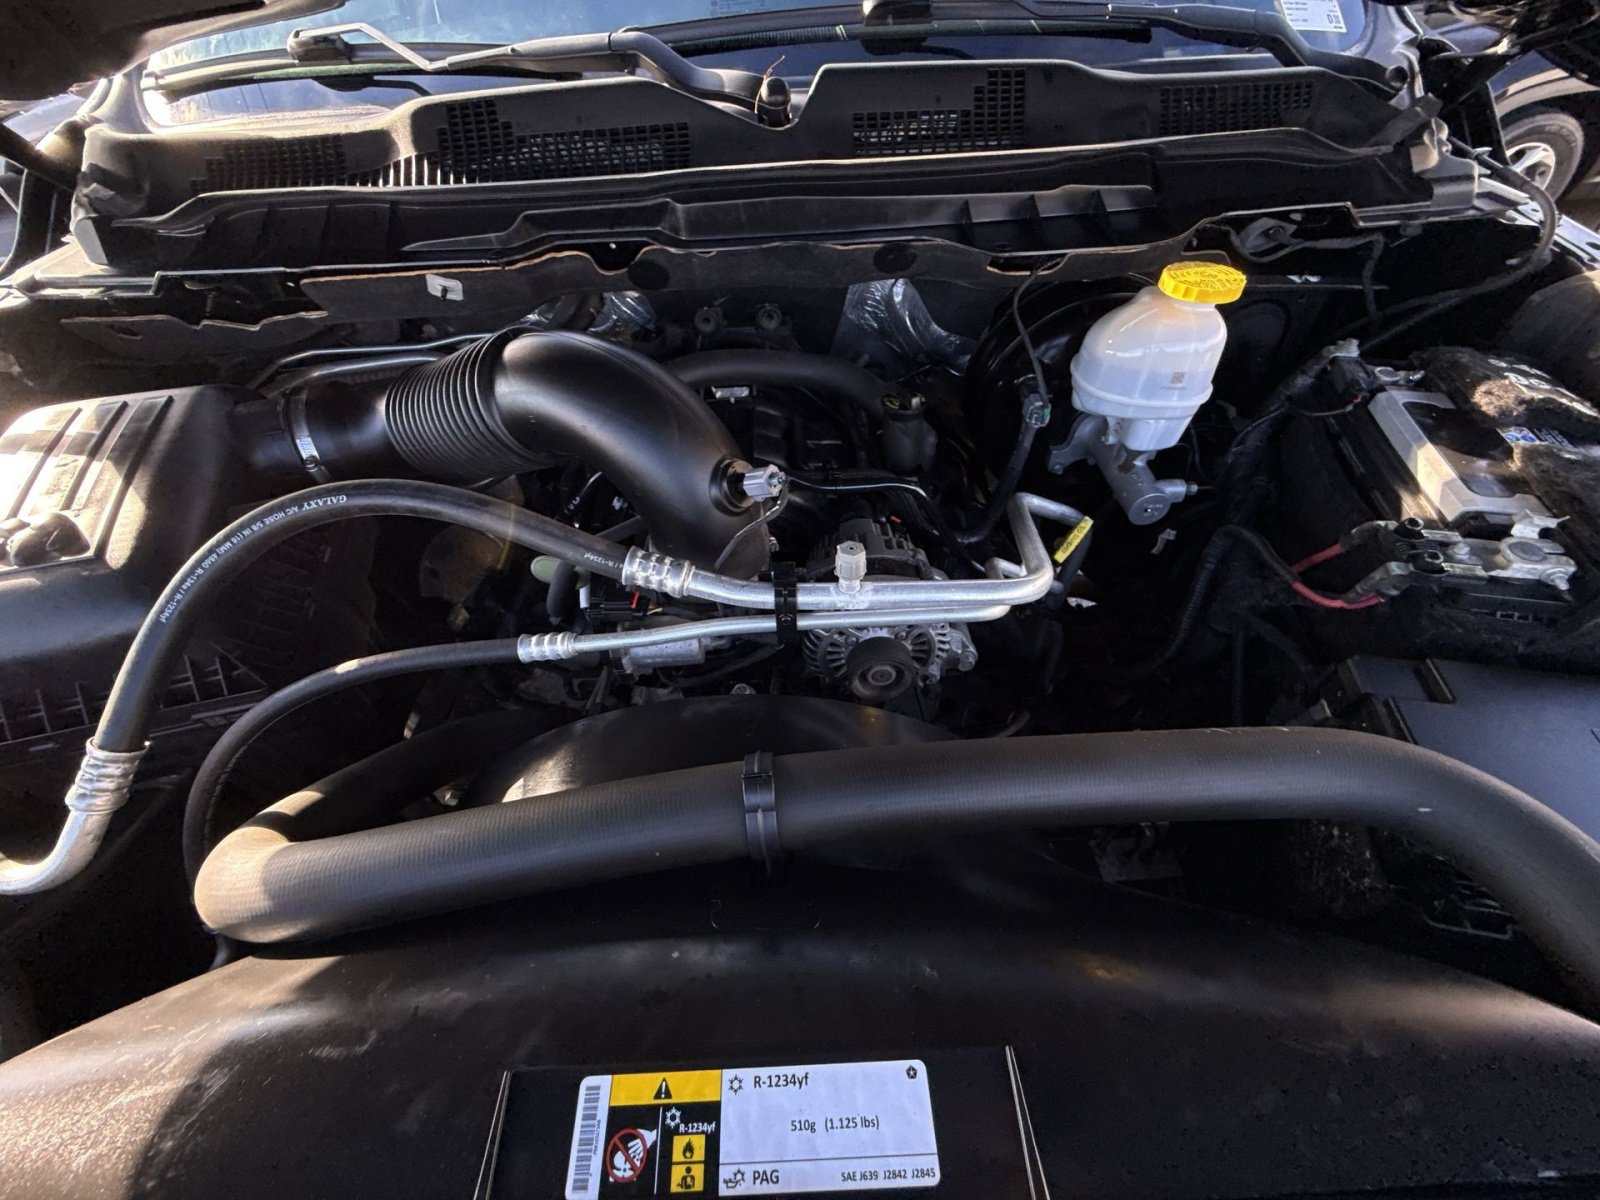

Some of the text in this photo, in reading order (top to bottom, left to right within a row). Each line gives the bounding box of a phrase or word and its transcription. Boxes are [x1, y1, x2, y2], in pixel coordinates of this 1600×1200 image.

[286, 505, 299, 515] A/C
[301, 494, 347, 511] GALAXY
[251, 521, 264, 531] 5/8
[264, 512, 286, 525] HOSE
[244, 526, 252, 536] IN
[216, 541, 233, 555] MM)
[181, 567, 204, 590] R-134a
[160, 592, 183, 623] R-1234yf
[753, 1072, 808, 1090] R-1234yf
[678, 1121, 716, 1134] R-1234yf
[790, 1115, 880, 1133] 510g (1.125 lbs)
[752, 1170, 780, 1185] PAG
[841, 1167, 936, 1182] SAE J639 J2842 J2845
